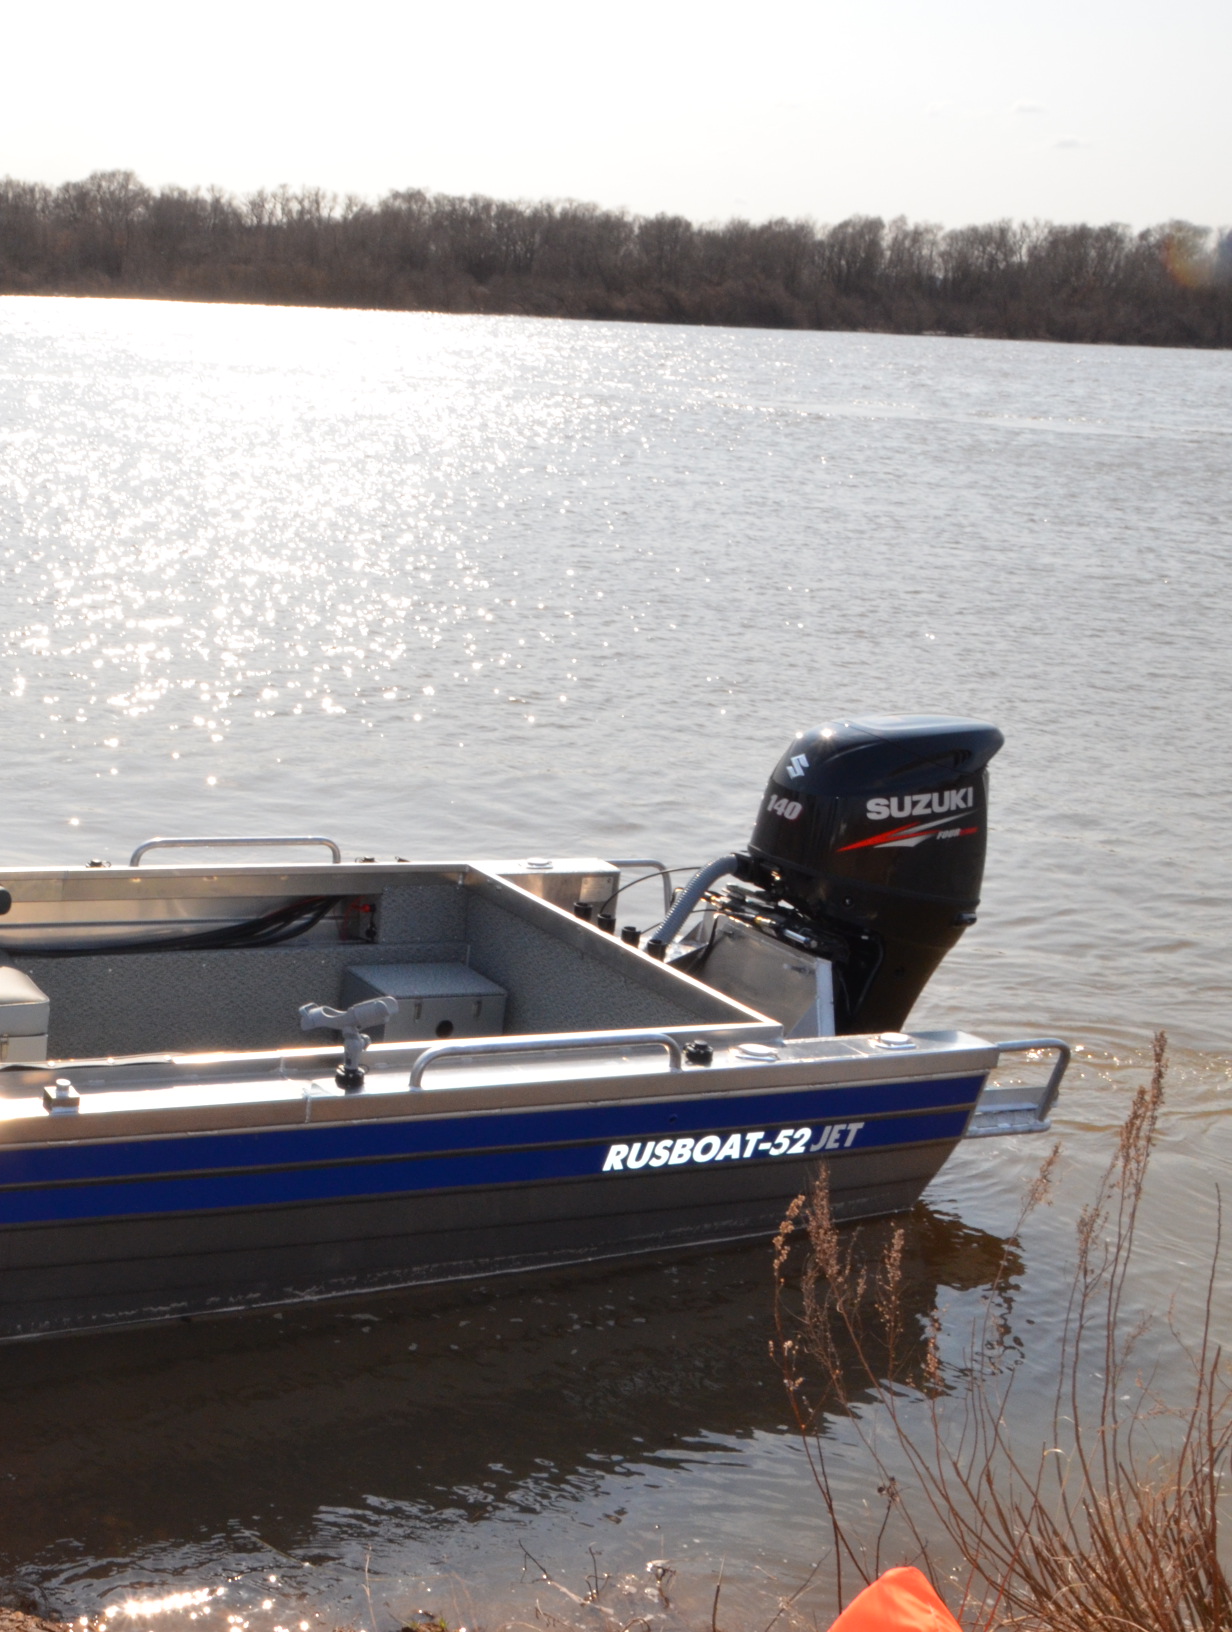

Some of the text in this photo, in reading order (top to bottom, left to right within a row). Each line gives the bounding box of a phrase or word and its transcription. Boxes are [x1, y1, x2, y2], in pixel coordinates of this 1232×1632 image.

[767, 794, 802, 820] 140
[866, 786, 973, 820] SUZUKI
[602, 1122, 865, 1171] RUSBOAT-52 JET
